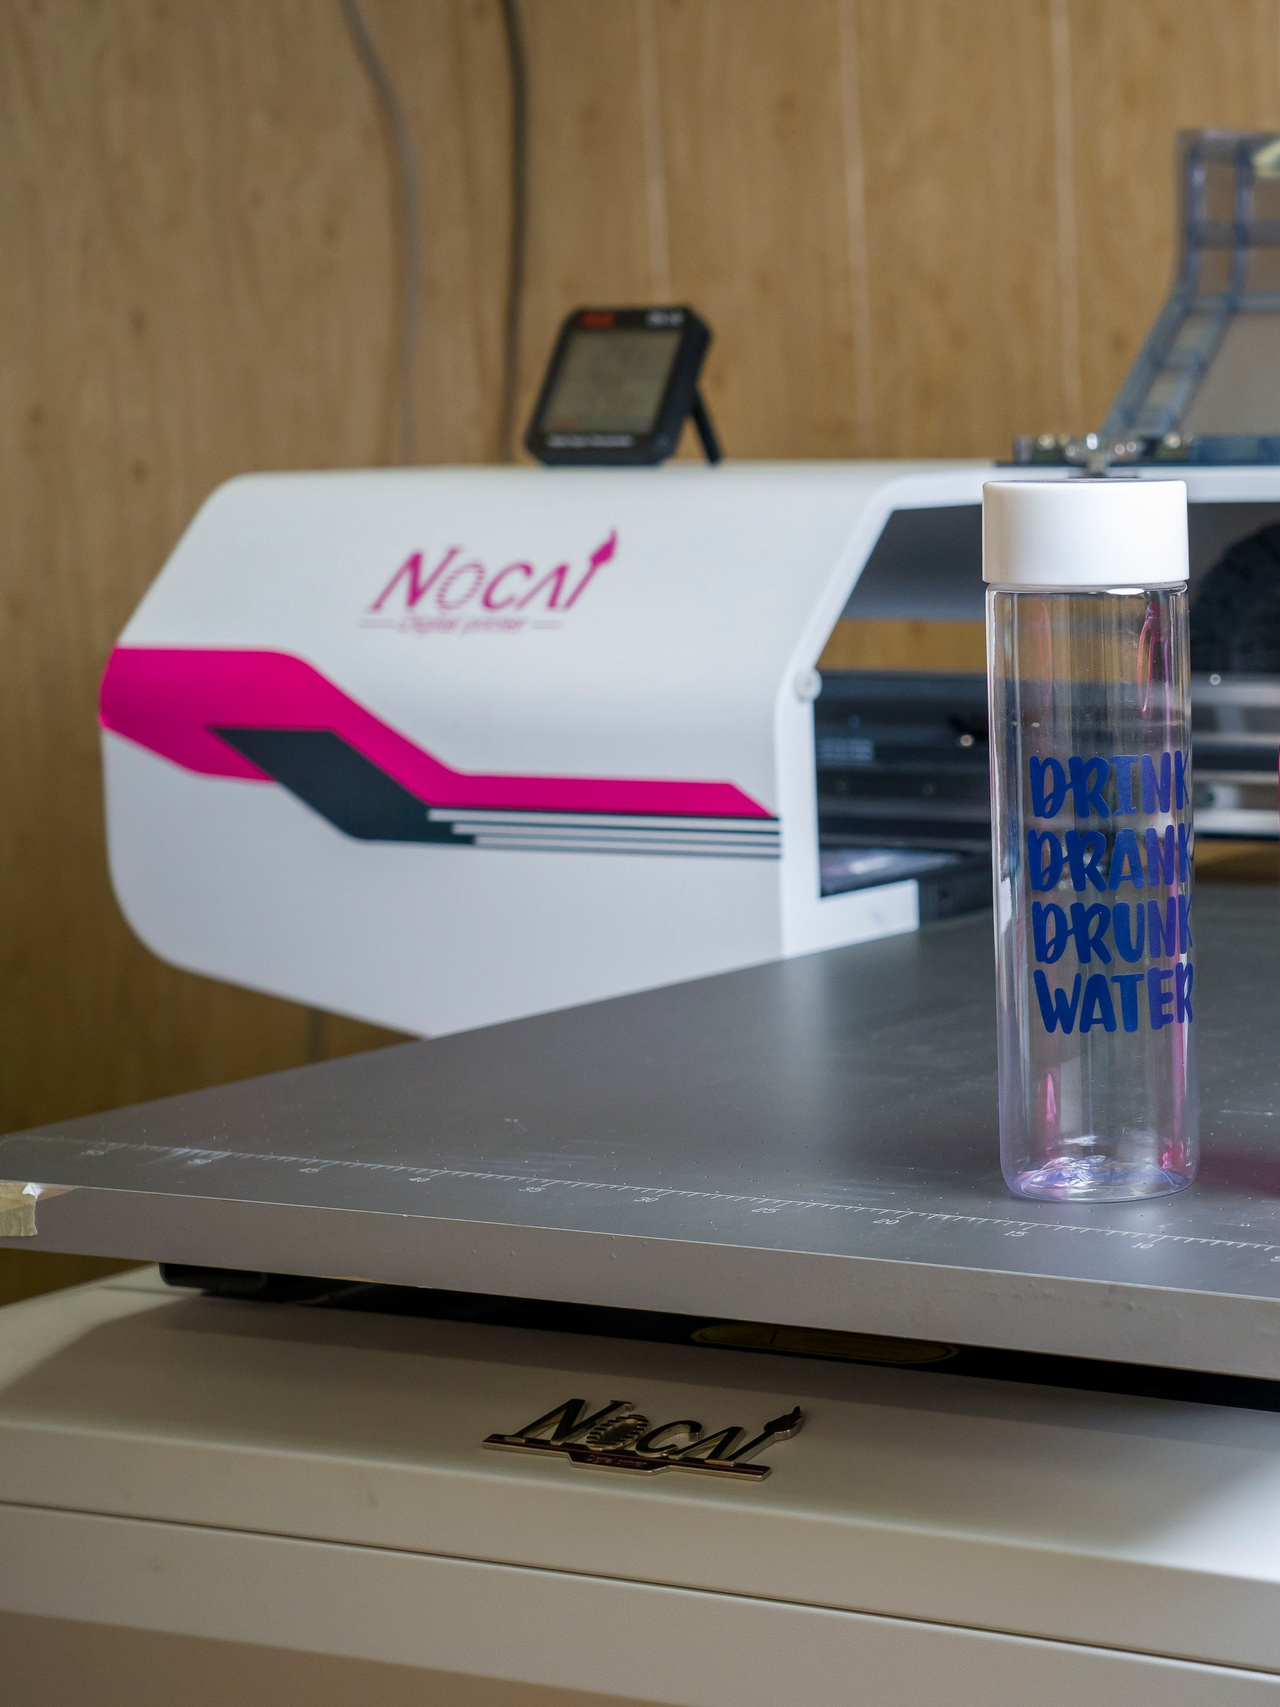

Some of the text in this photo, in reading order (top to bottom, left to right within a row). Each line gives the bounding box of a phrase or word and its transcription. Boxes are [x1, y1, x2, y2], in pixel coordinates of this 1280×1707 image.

[1029, 750, 1190, 819] DRINK
[1027, 822, 1192, 893] DRANK
[1031, 892, 1193, 965] DRUNK
[1033, 962, 1194, 1035] WATER
